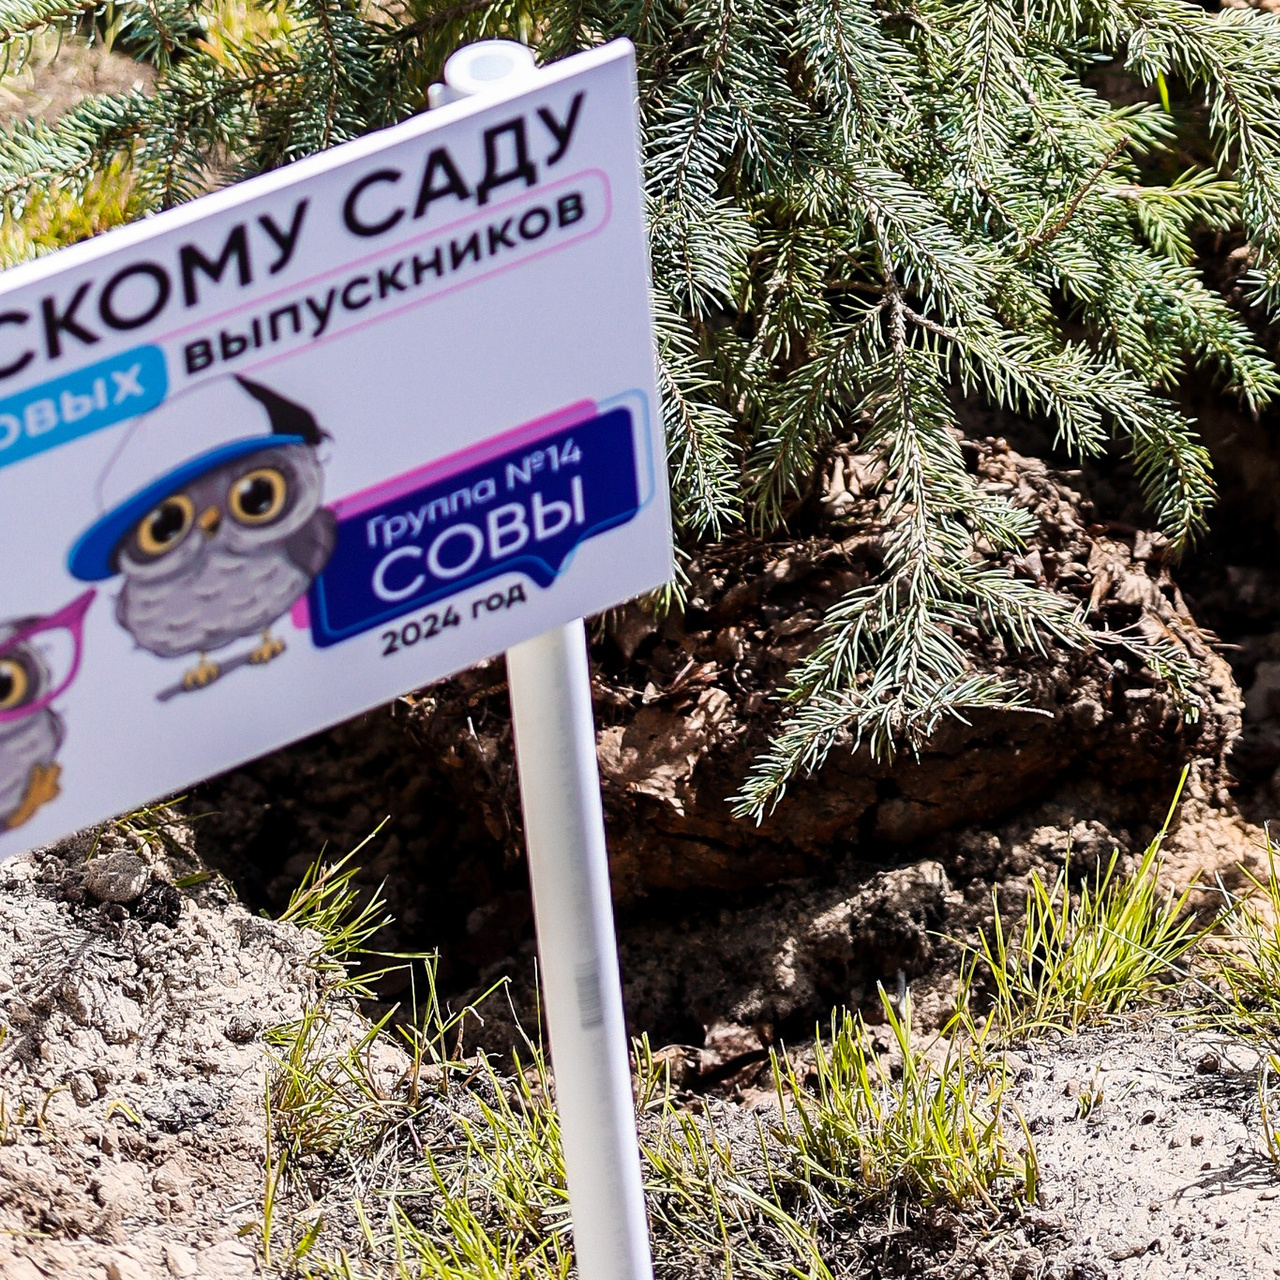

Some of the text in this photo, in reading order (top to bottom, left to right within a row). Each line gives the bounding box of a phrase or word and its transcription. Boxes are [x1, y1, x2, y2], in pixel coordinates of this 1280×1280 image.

[344, 91, 585, 237] САДУ
[367, 438, 582, 546] Группа №14
[372, 475, 585, 602] СОВЫ
[381, 583, 527, 657] 2024 год
